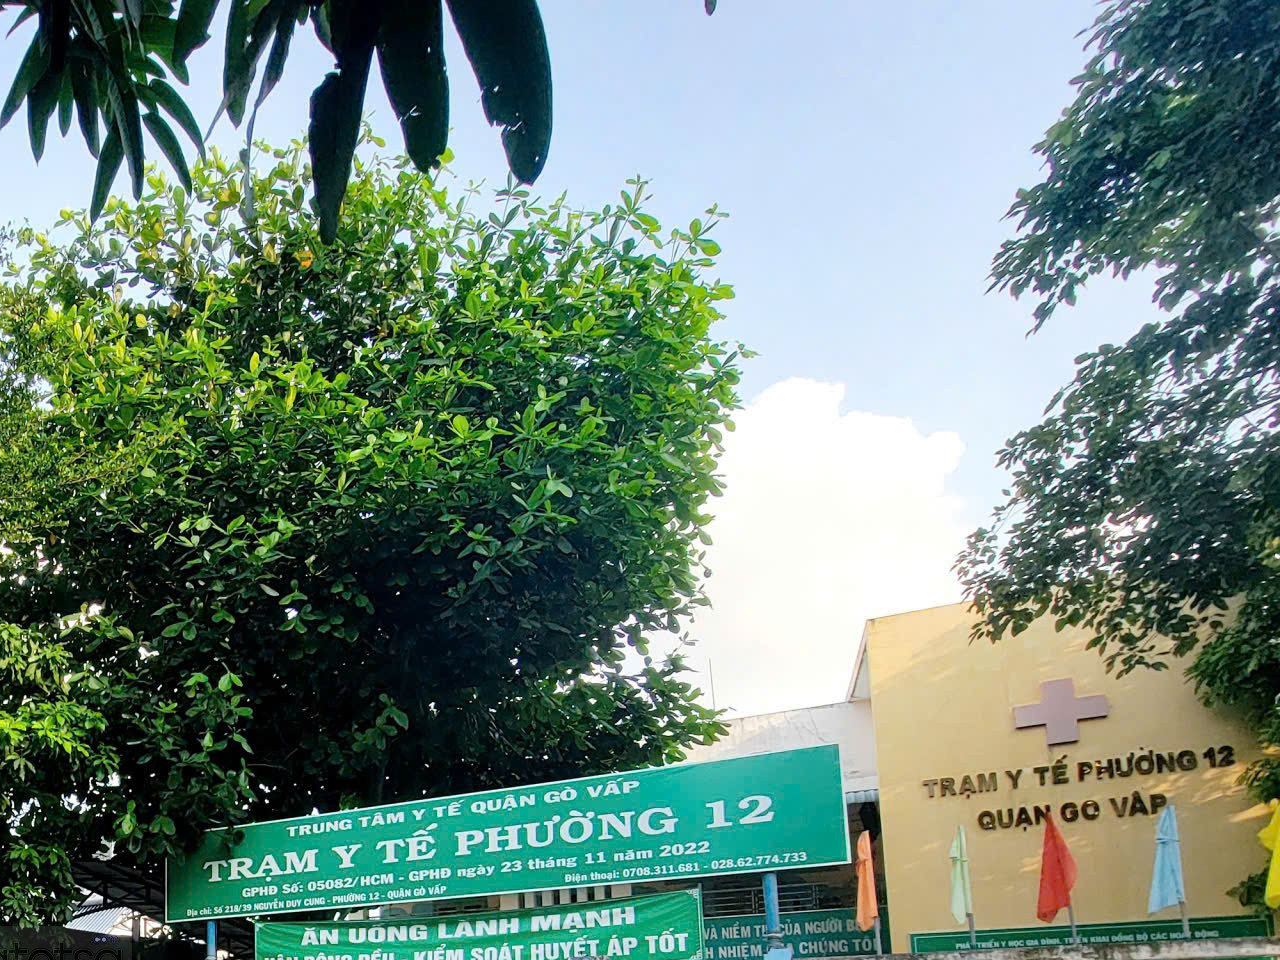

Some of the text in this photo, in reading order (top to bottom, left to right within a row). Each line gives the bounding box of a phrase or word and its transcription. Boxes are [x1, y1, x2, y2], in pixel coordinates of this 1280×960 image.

[923, 772, 997, 799] TRẠM
[1005, 769, 1023, 789] Y
[1033, 754, 1070, 787] TẾ
[1203, 745, 1236, 768] 12
[286, 777, 641, 837] TRUNG TÂM Y TẾ QUẬN GÒ VẤP
[203, 794, 775, 882] TRẠM Y TẾ PHƯỜNG 12
[242, 885, 278, 898] GPHĐ
[408, 867, 451, 882] GPHĐ
[457, 864, 495, 879] ngày
[501, 860, 523, 873] 23
[527, 856, 578, 870] tháng
[585, 851, 606, 864] 11
[614, 849, 653, 862] năm
[659, 841, 710, 857] 2022
[565, 871, 587, 883] Điện
[623, 862, 699, 878] 0708.311.681
[711, 851, 807, 870] 028.62.774.733
[286, 899, 302, 909] DUY
[304, 897, 325, 907] CUNG
[332, 892, 366, 904] PHƯỜNG
[369, 892, 380, 901] 12
[387, 888, 412, 900] QUẬN
[428, 883, 447, 896] VẤP
[301, 926, 339, 946] ĂN
[530, 906, 636, 934] MẠNH
[531, 935, 600, 960] HUYẾT
[607, 935, 639, 957] ÁP
[645, 927, 689, 954] TỐT
[718, 942, 761, 960] NHIỆM
[799, 937, 848, 957] CHÚNG
